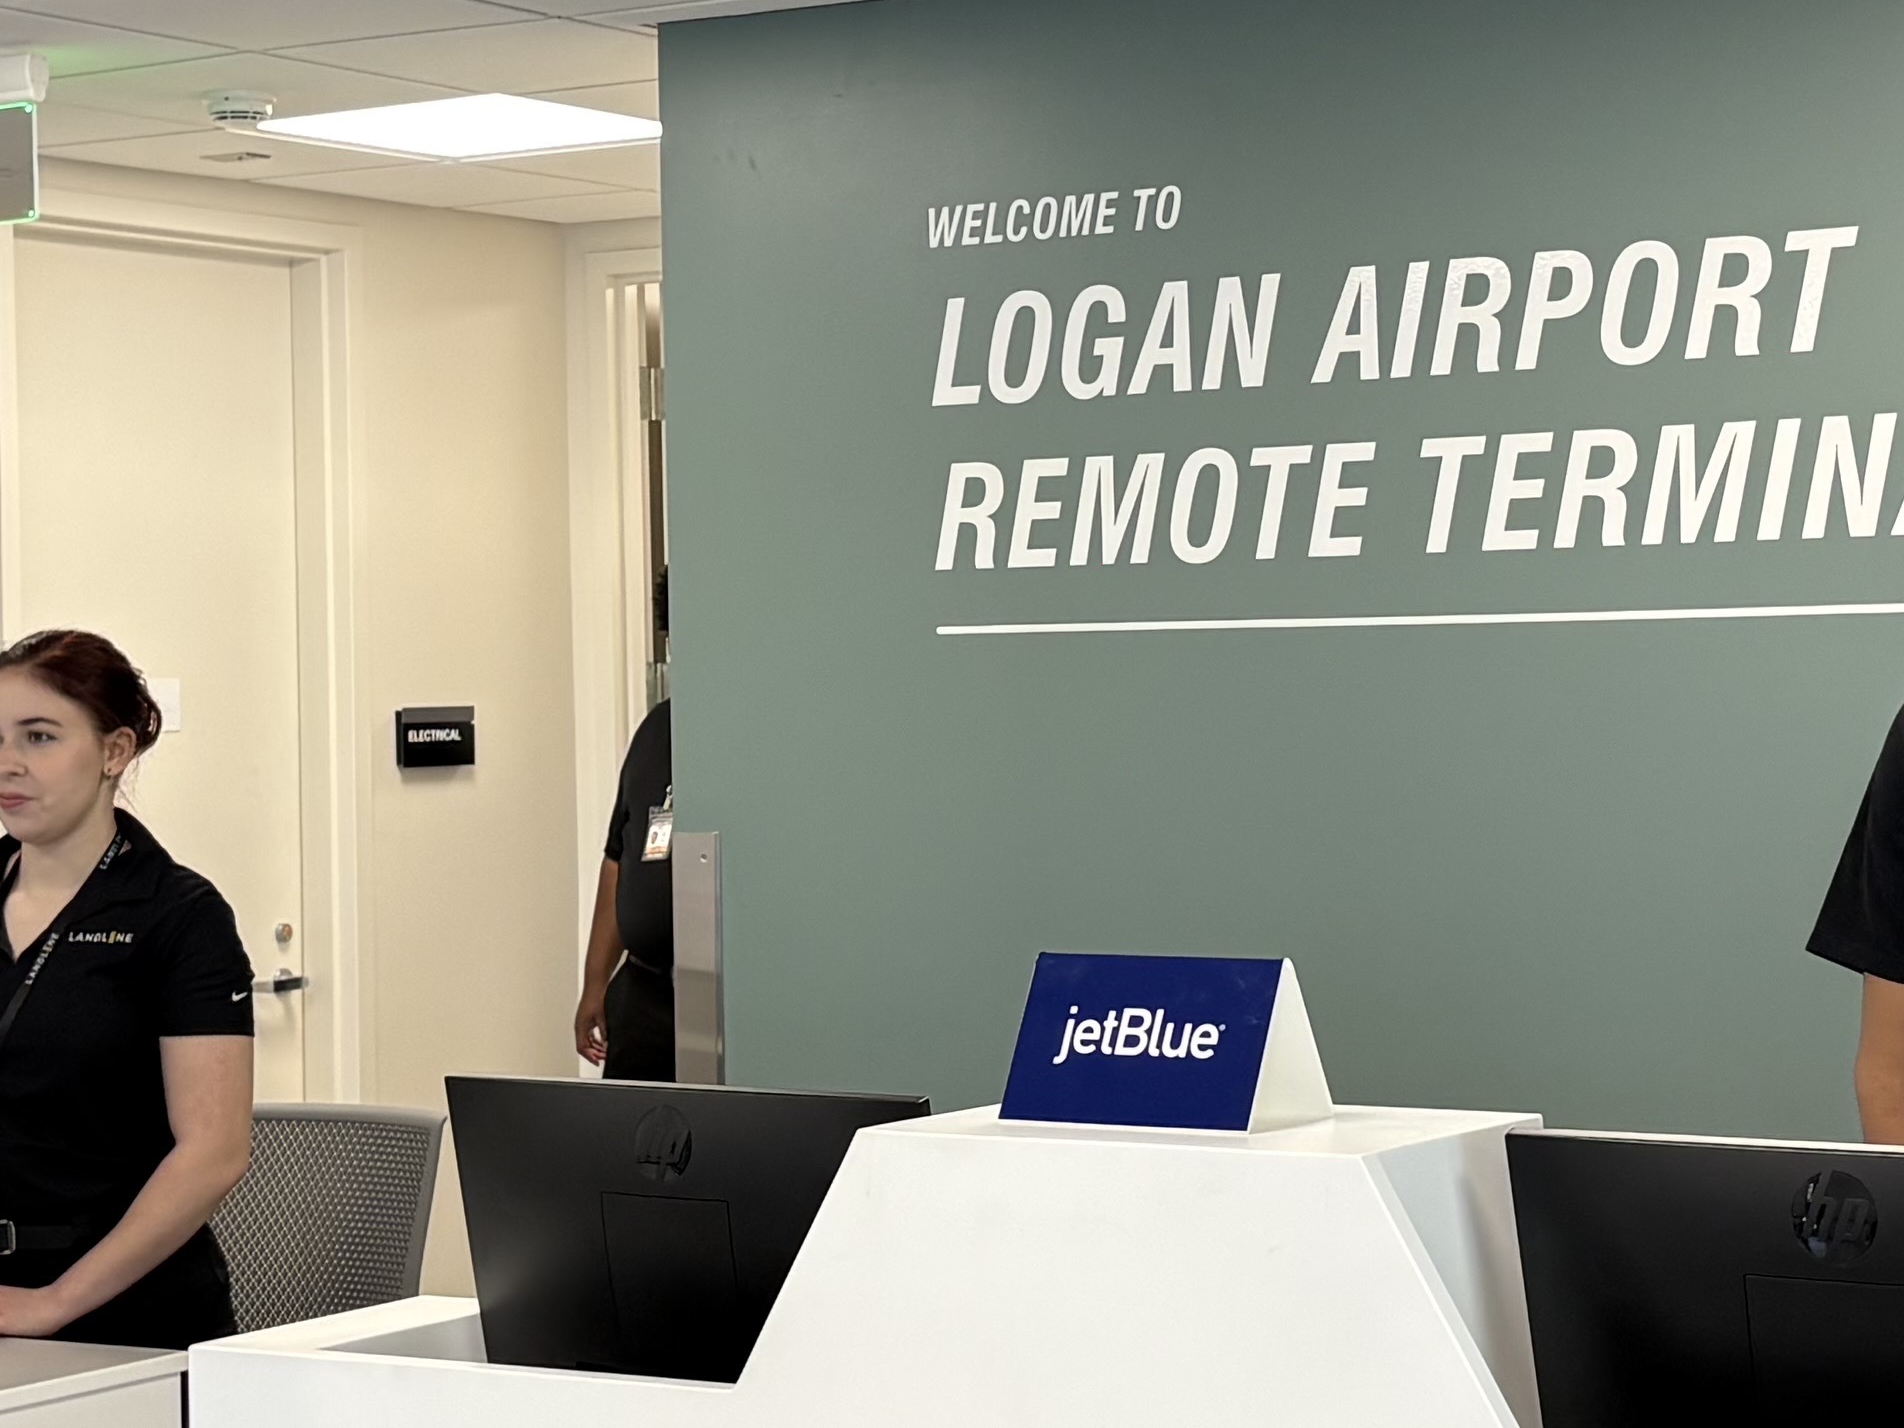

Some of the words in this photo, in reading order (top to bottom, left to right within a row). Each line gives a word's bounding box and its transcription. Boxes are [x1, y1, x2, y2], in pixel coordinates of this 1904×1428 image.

[928, 191, 1119, 249] WELCOME
[1133, 185, 1182, 231] TO
[931, 272, 1281, 407] LOGAN
[1310, 225, 1860, 384] AIRPORT
[934, 441, 1377, 571] REMOTE
[407, 728, 462, 743] ELECTRICAL
[68, 930, 134, 944] LANDLINE
[1053, 1005, 1221, 1065] jetBlue
